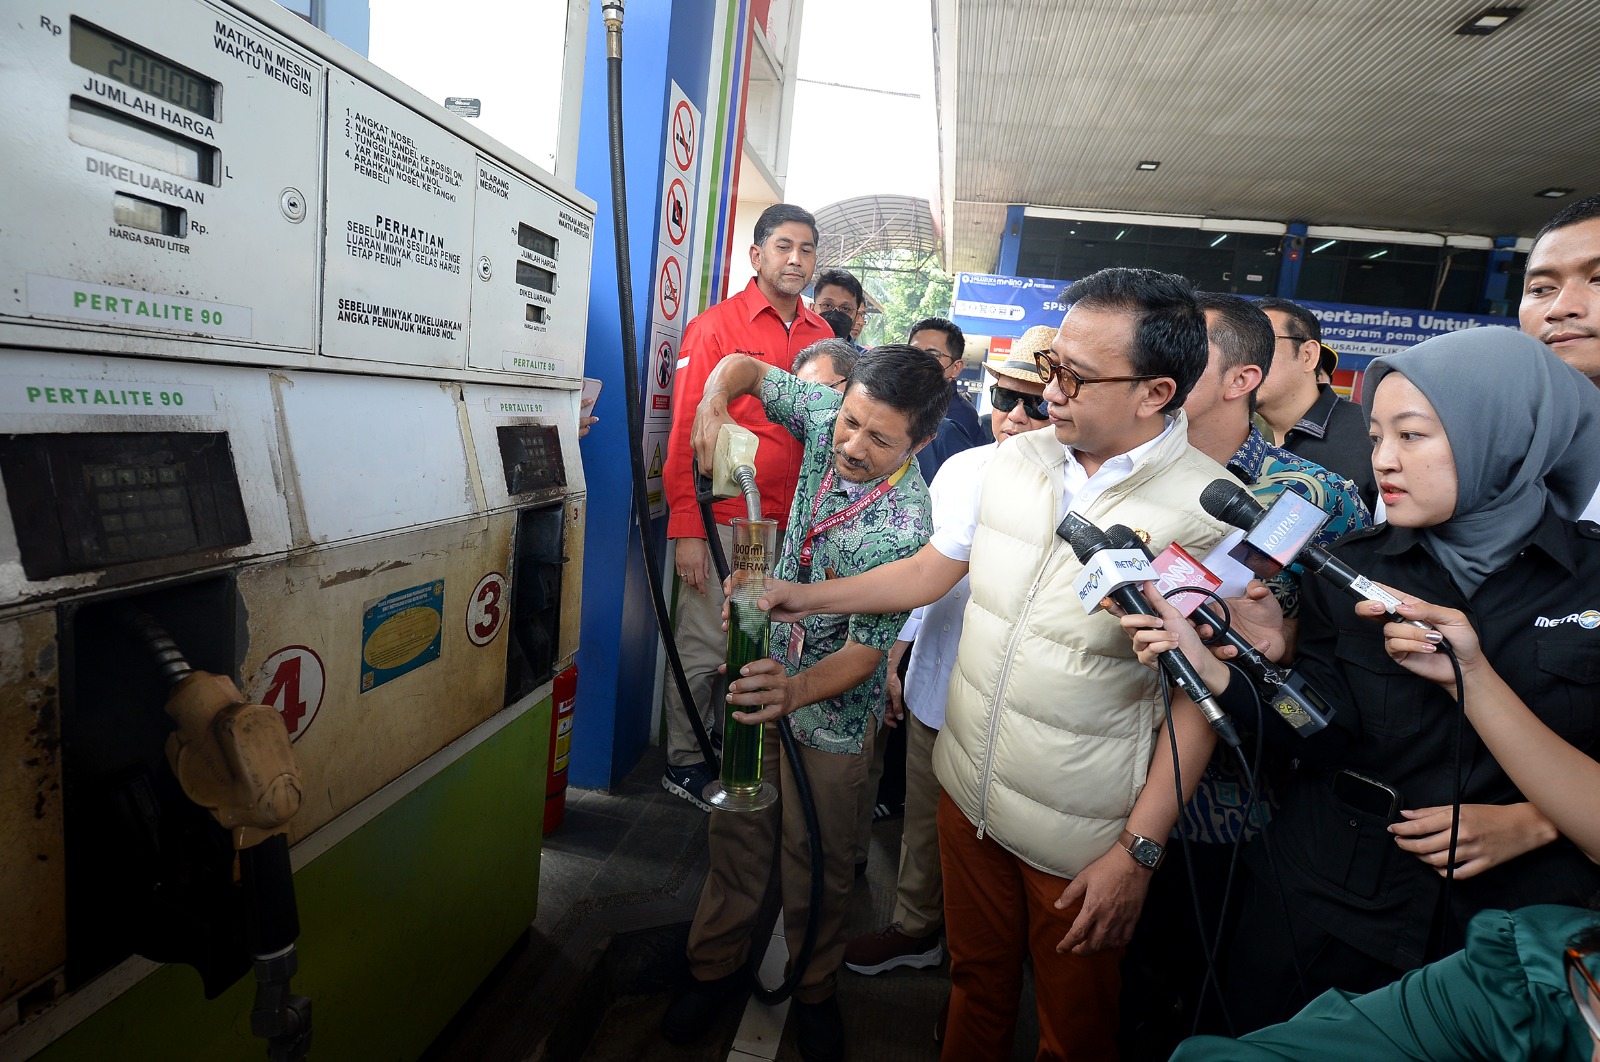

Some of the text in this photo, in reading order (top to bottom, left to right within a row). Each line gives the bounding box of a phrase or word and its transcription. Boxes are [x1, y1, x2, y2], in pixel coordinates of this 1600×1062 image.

[40, 15, 62, 36] Rp
[213, 35, 312, 97] WAKTU MENGISI
[215, 20, 311, 83] MATIKAN MESIN
[108, 43, 202, 113] 20000
[84, 78, 215, 139] JUMLAH HARGA
[345, 108, 418, 150] 1. ANGKAT NOSEL.
[345, 118, 464, 181] 2. NAIKAN HANDEL KE POSISI ON.
[345, 128, 353, 139] 3.
[355, 132, 390, 155] TUNGGU
[391, 150, 419, 169] SAMPAI
[420, 164, 444, 180] LAMPU
[355, 142, 371, 157] YAR
[374, 152, 425, 181] MENUNJUKAN
[86, 156, 205, 205] DIKELUARKAN
[225, 165, 233, 179] L
[344, 149, 456, 203] 4. ARAHKAN NOSEL KE TANGKI
[354, 163, 390, 185] PEMBELI
[479, 168, 509, 190] DILARANG
[479, 178, 509, 200] MEROKOK
[109, 227, 190, 254] HARGA SATU LITER
[191, 220, 209, 235] Rp.
[347, 220, 387, 241] SEBELUM
[389, 233, 405, 246] DAN
[406, 239, 439, 258] SESUDAH
[376, 214, 444, 249] PERHATIAN
[346, 232, 460, 275] LUARAN MINYAK, GELAS HARUS
[346, 244, 402, 268] TETAP PENUH
[521, 250, 557, 269] JUMLAH HARGA
[74, 291, 223, 326] PERTALITE 90
[519, 288, 552, 304] DIKELUARKAN
[337, 310, 456, 340] ANGKA PENUNJUK HARUS NOL.
[338, 298, 462, 332] SEBELUM MINYAK DIKELUARKAN
[513, 357, 555, 371] PERTALITE 90
[1332, 343, 1366, 352] USAHA
[26, 386, 184, 406] PERTALITE 90
[500, 403, 543, 412] PERTALITE 90
[573, 507, 579, 521] 3
[813, 490, 881, 532] PT Molino Pramuka
[1264, 510, 1300, 550] KOMPAS
[733, 561, 770, 571] HERMA
[1154, 556, 1195, 597] CNN
[474, 580, 500, 638] 3
[260, 655, 307, 735] 4
